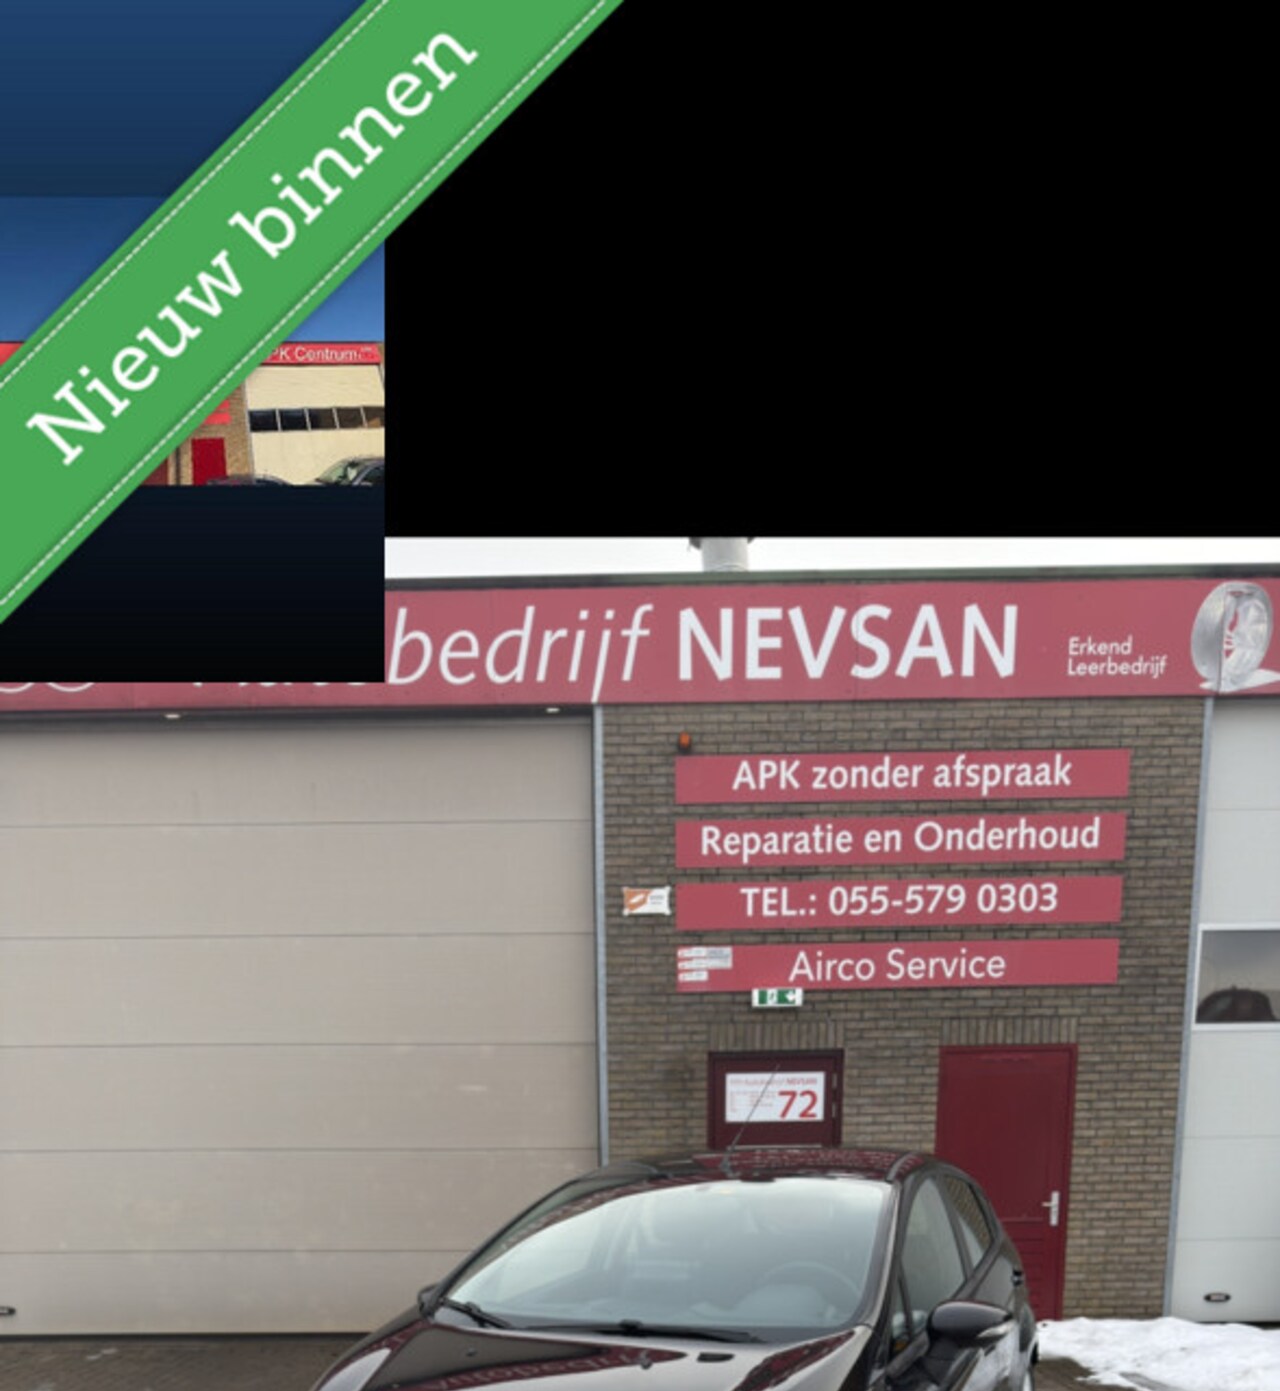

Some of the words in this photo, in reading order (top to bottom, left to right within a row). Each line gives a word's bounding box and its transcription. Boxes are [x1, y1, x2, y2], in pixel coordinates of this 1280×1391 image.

[679, 603, 1018, 682] NEVSAN
[1068, 636, 1133, 656] Erkend
[1067, 655, 1168, 679] Leerbedrijf
[732, 761, 801, 791] APK
[811, 756, 924, 788] zonder
[933, 753, 1072, 797] afspraak
[701, 821, 853, 865] Reparatie
[863, 829, 902, 853] en
[914, 816, 1101, 853] Onderhoud
[739, 887, 816, 917] TEL.:
[828, 884, 966, 916] 055-579
[977, 882, 1058, 914] 0303
[788, 952, 875, 982] Airco
[886, 948, 1006, 979] Service
[778, 1089, 818, 1119] 72
